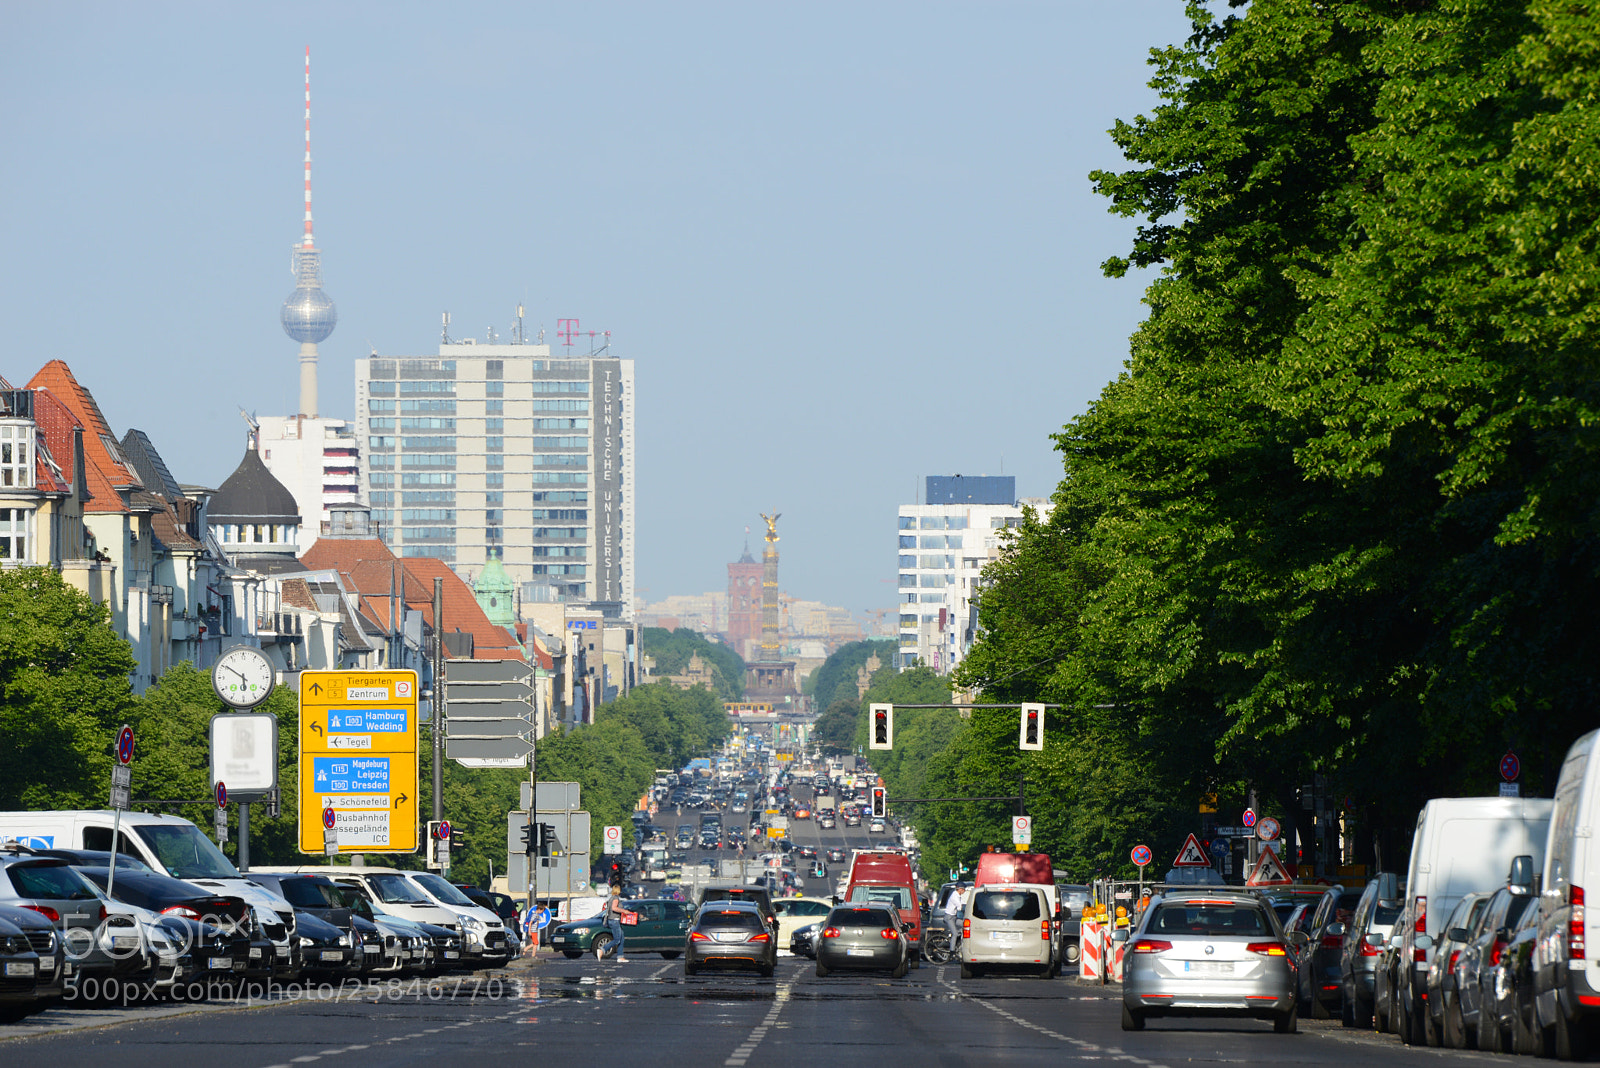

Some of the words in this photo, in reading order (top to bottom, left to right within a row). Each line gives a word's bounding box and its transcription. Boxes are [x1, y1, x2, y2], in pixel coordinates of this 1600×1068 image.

[604, 370, 612, 481] TECHNISCHE
[347, 677, 392, 686] Tiergarten
[350, 690, 386, 698] Zentrum
[366, 712, 405, 722] Hamburg
[366, 722, 403, 731] Wedding
[346, 738, 369, 747] Tegel
[352, 760, 388, 770] Magdeburg
[358, 770, 388, 780] Leipzig
[352, 781, 388, 789] Dresden
[340, 798, 388, 806] Schönefeld
[336, 814, 388, 822] Busbahnhof
[333, 824, 388, 834] essegelände
